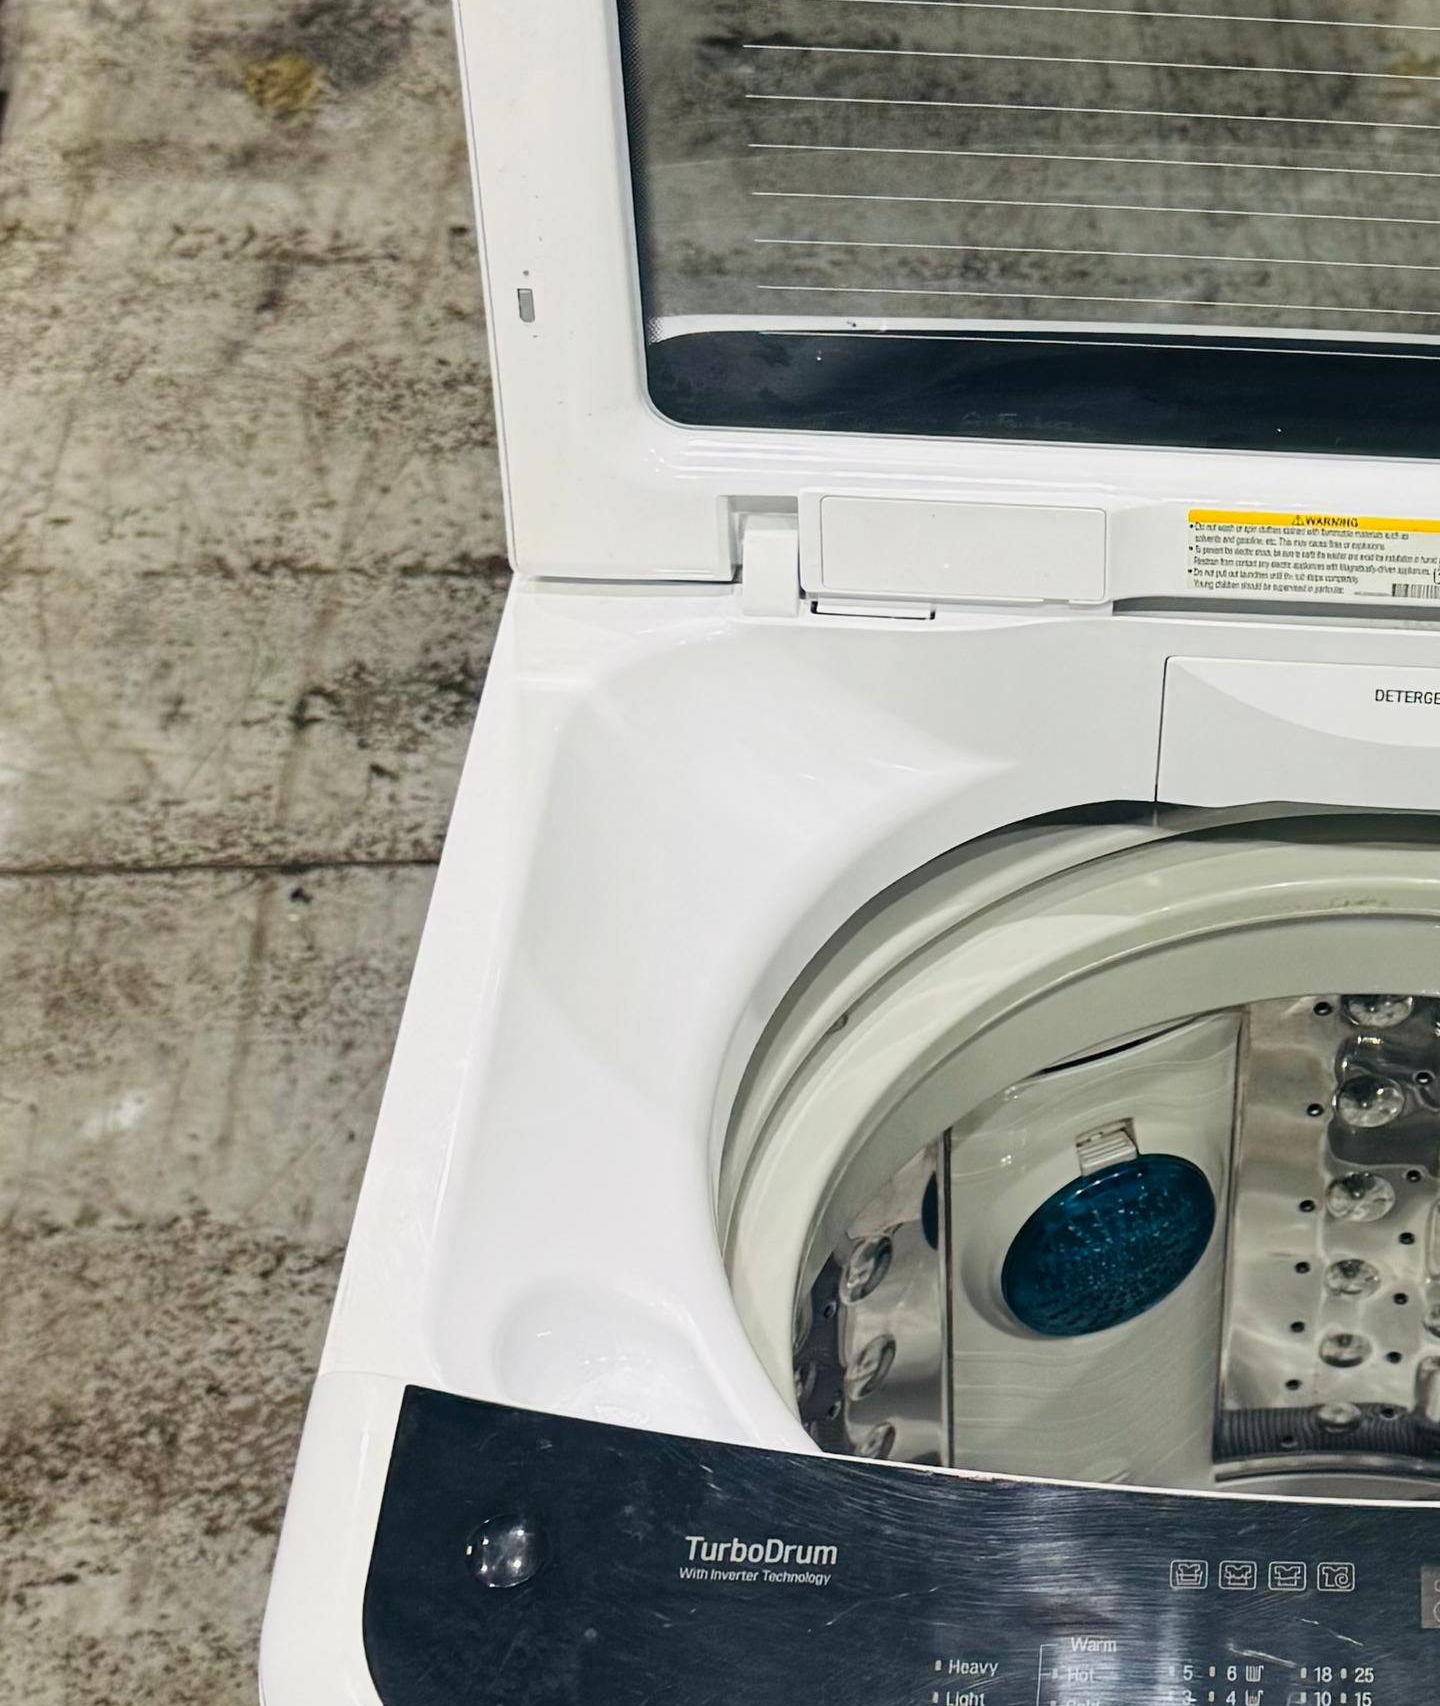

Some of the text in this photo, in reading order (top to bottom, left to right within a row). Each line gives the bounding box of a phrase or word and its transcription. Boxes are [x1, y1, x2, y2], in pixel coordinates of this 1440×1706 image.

[1305, 516, 1359, 528] WARNING
[685, 1536, 838, 1565] TurboDrum
[679, 1567, 831, 1585] With Inverter Technology
[1070, 1637, 1117, 1653] Warm
[949, 1659, 998, 1677] Heavy
[1067, 1668, 1095, 1684] Hot
[1183, 1665, 1237, 1682] 5 6
[1314, 1667, 1374, 1683] 18 25
[1225, 1690, 1236, 1706] 4
[1314, 1692, 1331, 1706] 10
